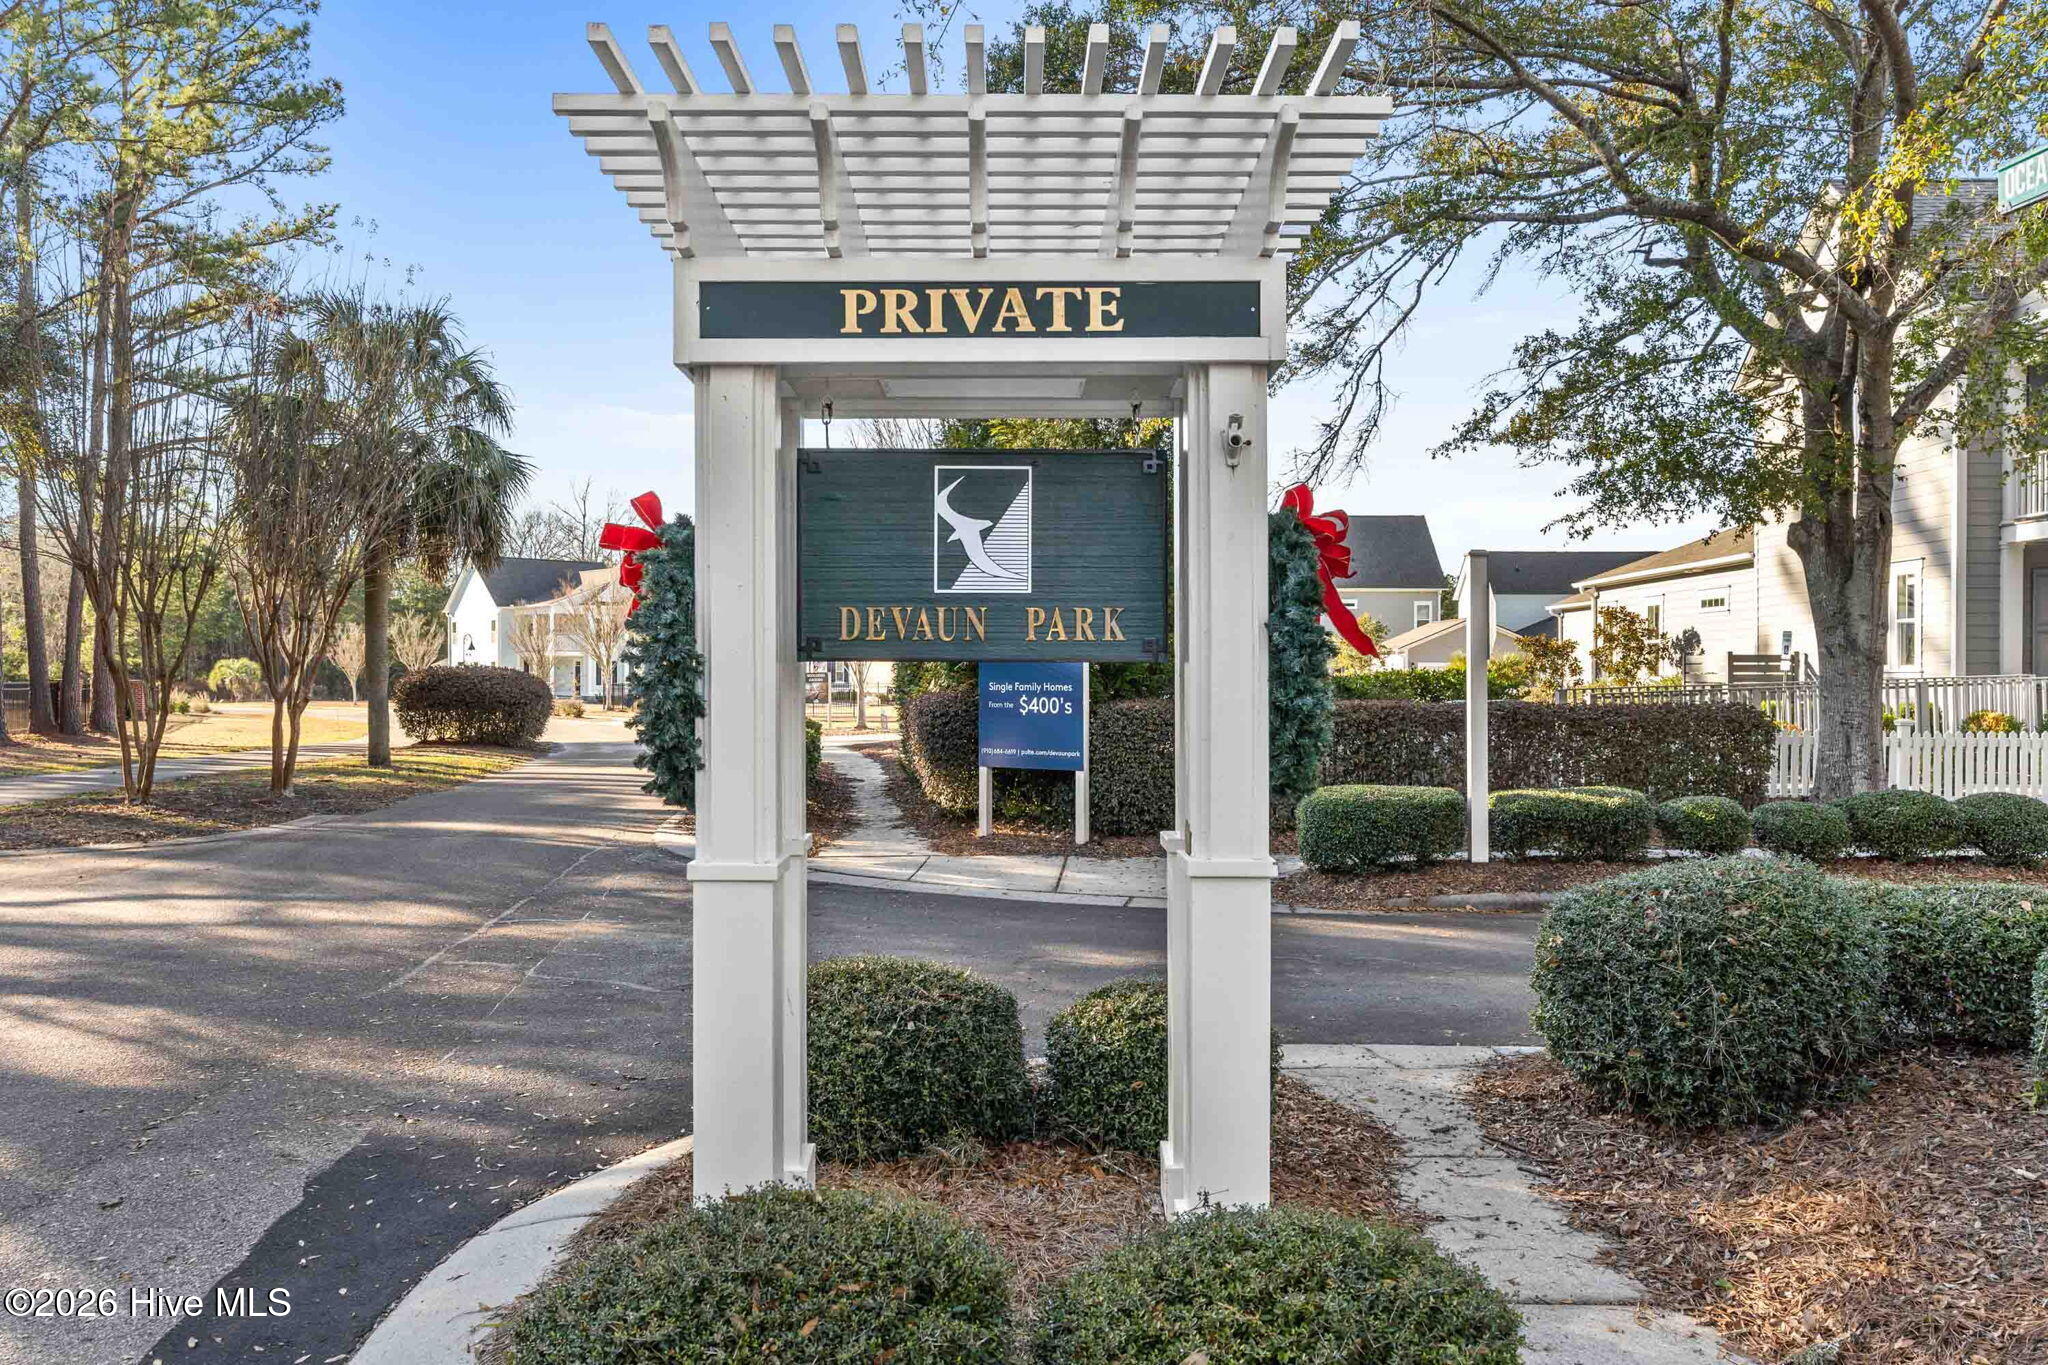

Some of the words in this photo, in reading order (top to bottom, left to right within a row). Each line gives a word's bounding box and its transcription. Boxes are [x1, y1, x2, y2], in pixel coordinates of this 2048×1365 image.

[2005, 155, 2048, 198] OCEA
[840, 286, 1125, 334] PRIVATE
[838, 605, 988, 642] DEVAUN
[1025, 605, 1127, 642] PARK
[988, 682, 1013, 693] Single
[1014, 682, 1041, 694] Family
[1043, 683, 1073, 692] Homes
[988, 701, 1003, 709] From
[1004, 701, 1014, 709] the
[1019, 694, 1073, 716] $400's
